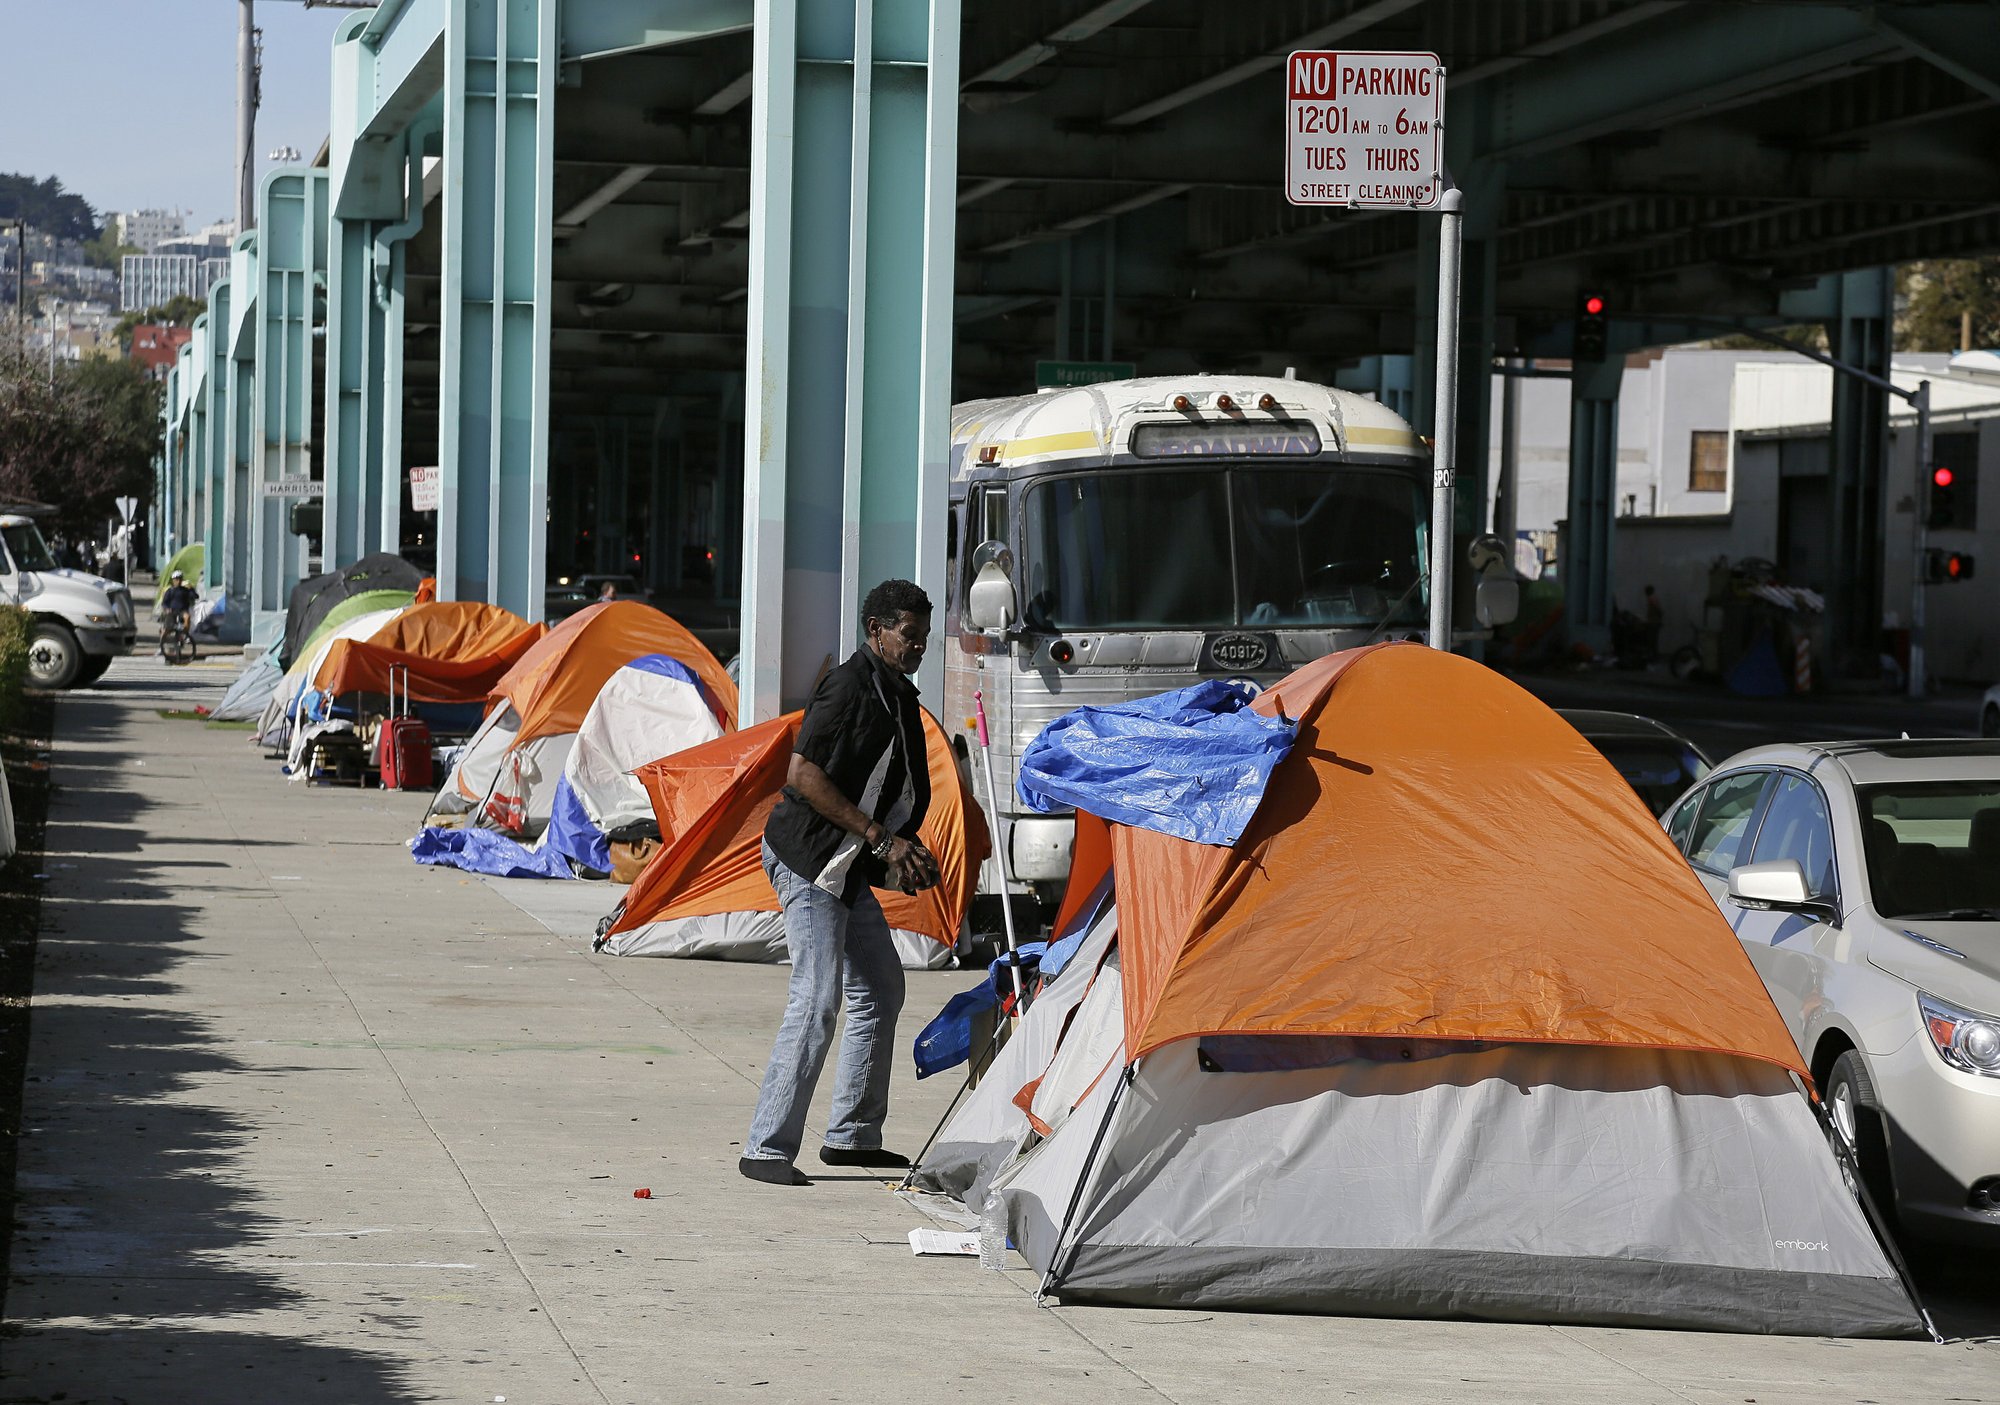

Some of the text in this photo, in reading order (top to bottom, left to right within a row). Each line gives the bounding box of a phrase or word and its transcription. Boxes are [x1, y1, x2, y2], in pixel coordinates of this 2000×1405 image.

[1295, 57, 1431, 96] NO PARKING
[1297, 105, 1348, 134] 12:01
[1377, 124, 1388, 135] TO
[1305, 147, 1420, 172] TUES THURS
[1300, 183, 1424, 200] STREET CLEANING
[1057, 368, 1114, 382] Harrison
[412, 470, 424, 482] NO
[270, 485, 324, 494] HARRISON
[1220, 645, 1258, 659] 40917
[1775, 1239, 1829, 1252] embark
